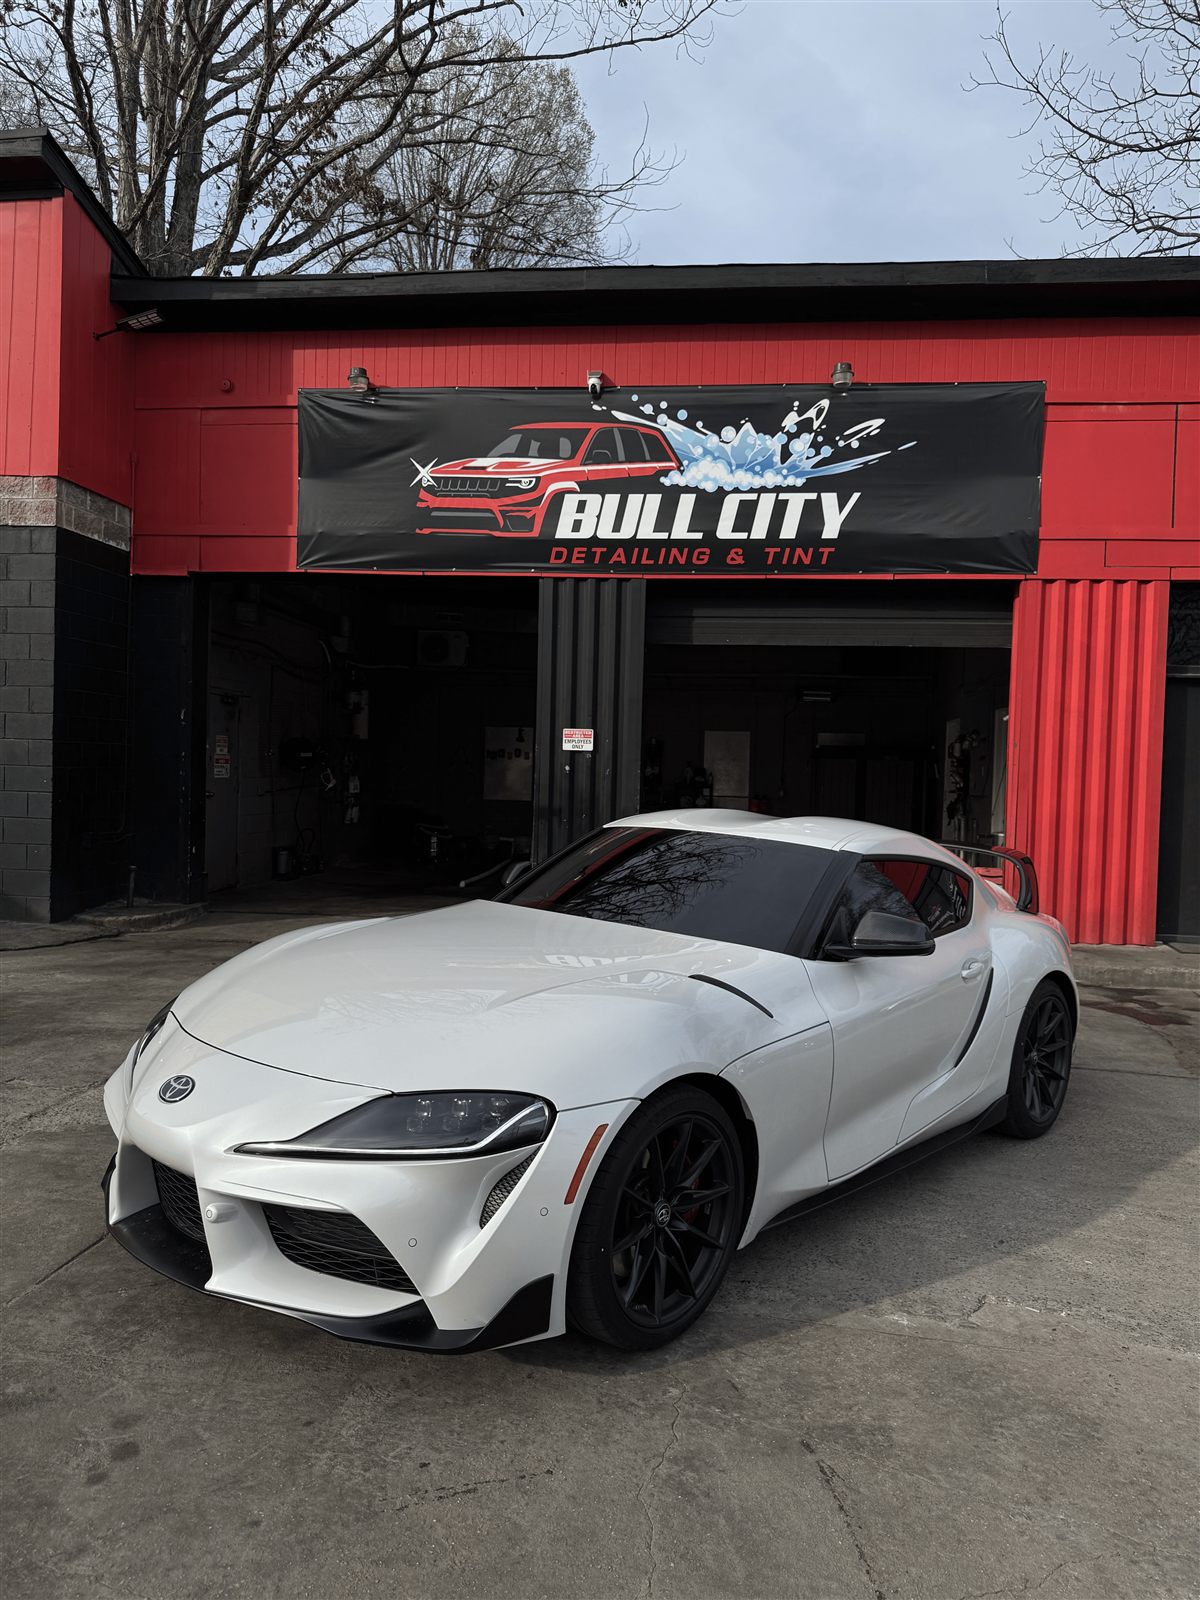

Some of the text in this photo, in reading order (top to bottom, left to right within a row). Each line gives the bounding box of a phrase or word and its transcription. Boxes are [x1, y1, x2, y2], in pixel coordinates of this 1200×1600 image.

[555, 492, 861, 540] BULL CITY
[550, 547, 835, 565] DETAILING & TINT
